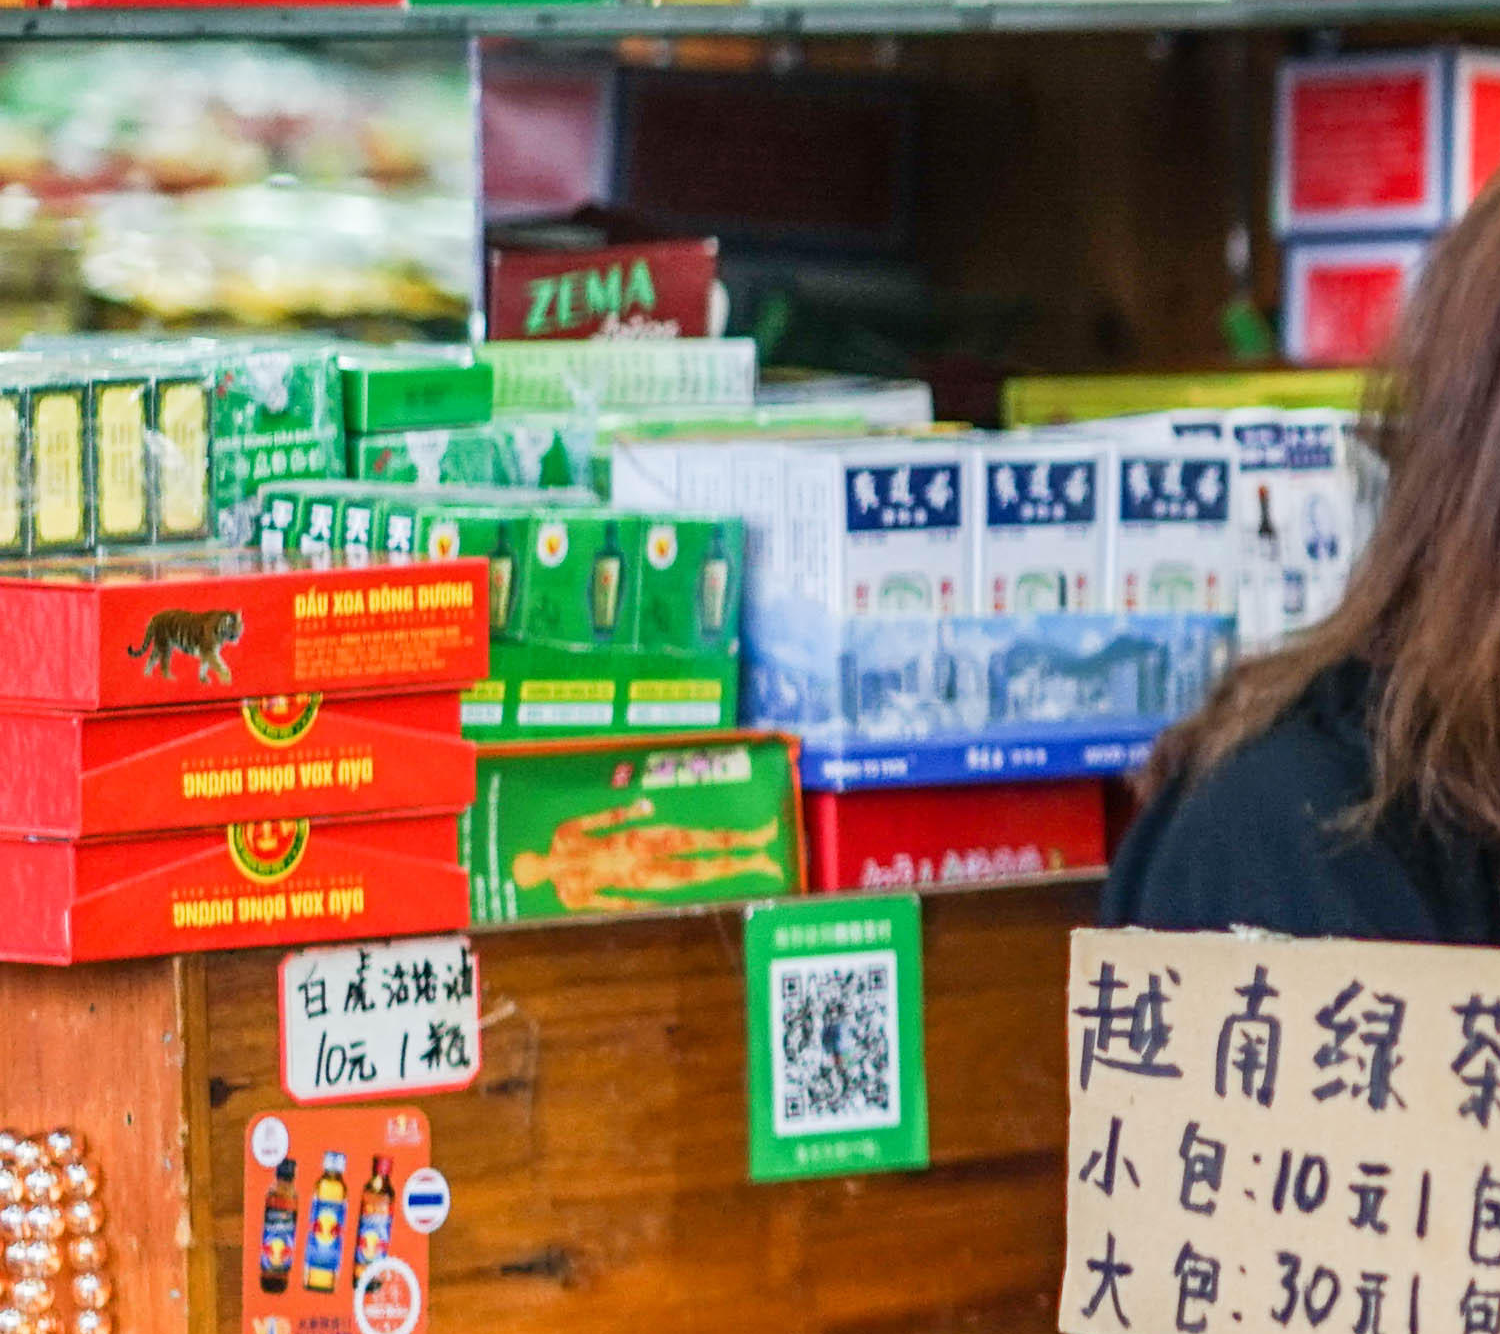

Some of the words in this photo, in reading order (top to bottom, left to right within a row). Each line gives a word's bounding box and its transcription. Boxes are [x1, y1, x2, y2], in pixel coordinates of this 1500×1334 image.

[526, 259, 657, 335] ZEMA
[333, 590, 364, 616] XOA
[300, 760, 333, 786] XOA
[291, 891, 324, 916] XOA
[315, 1021, 471, 1087] 10元1瓶
